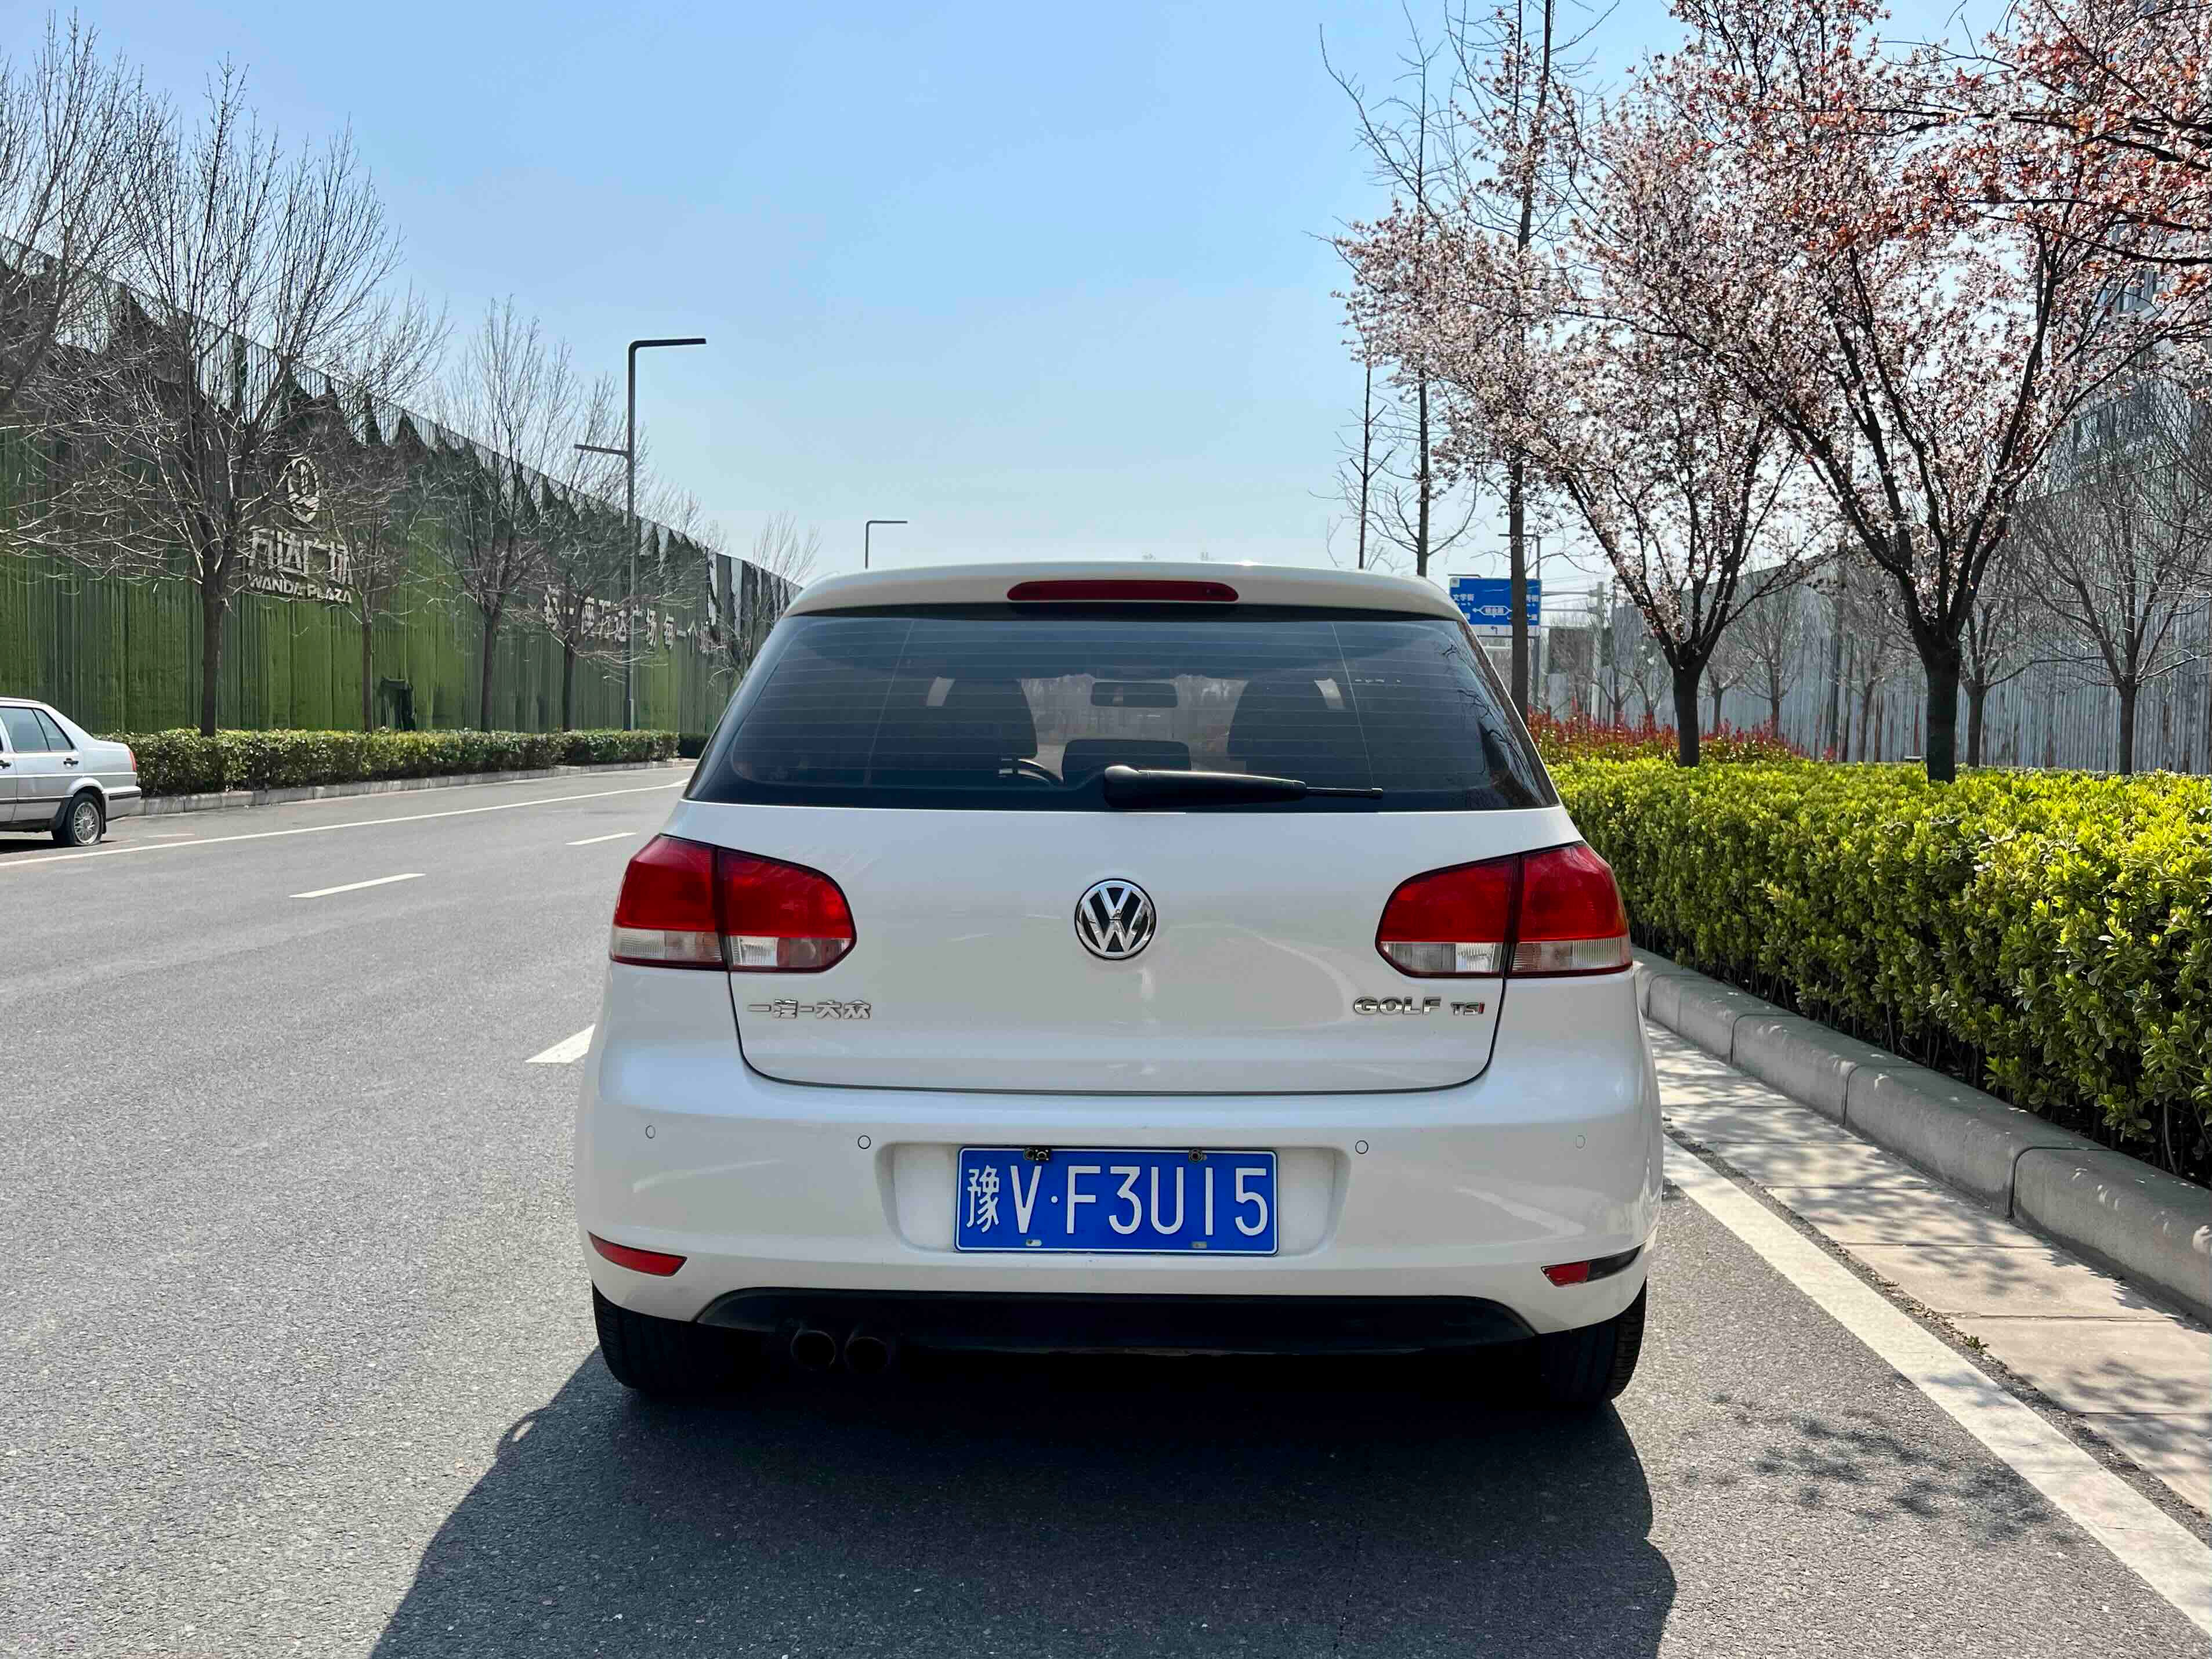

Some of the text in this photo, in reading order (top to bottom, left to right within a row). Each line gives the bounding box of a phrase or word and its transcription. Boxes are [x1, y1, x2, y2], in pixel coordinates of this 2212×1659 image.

[1353, 996, 1485, 1016] GOLF TSI
[966, 1165, 1269, 1236] 豫V·F3U15
